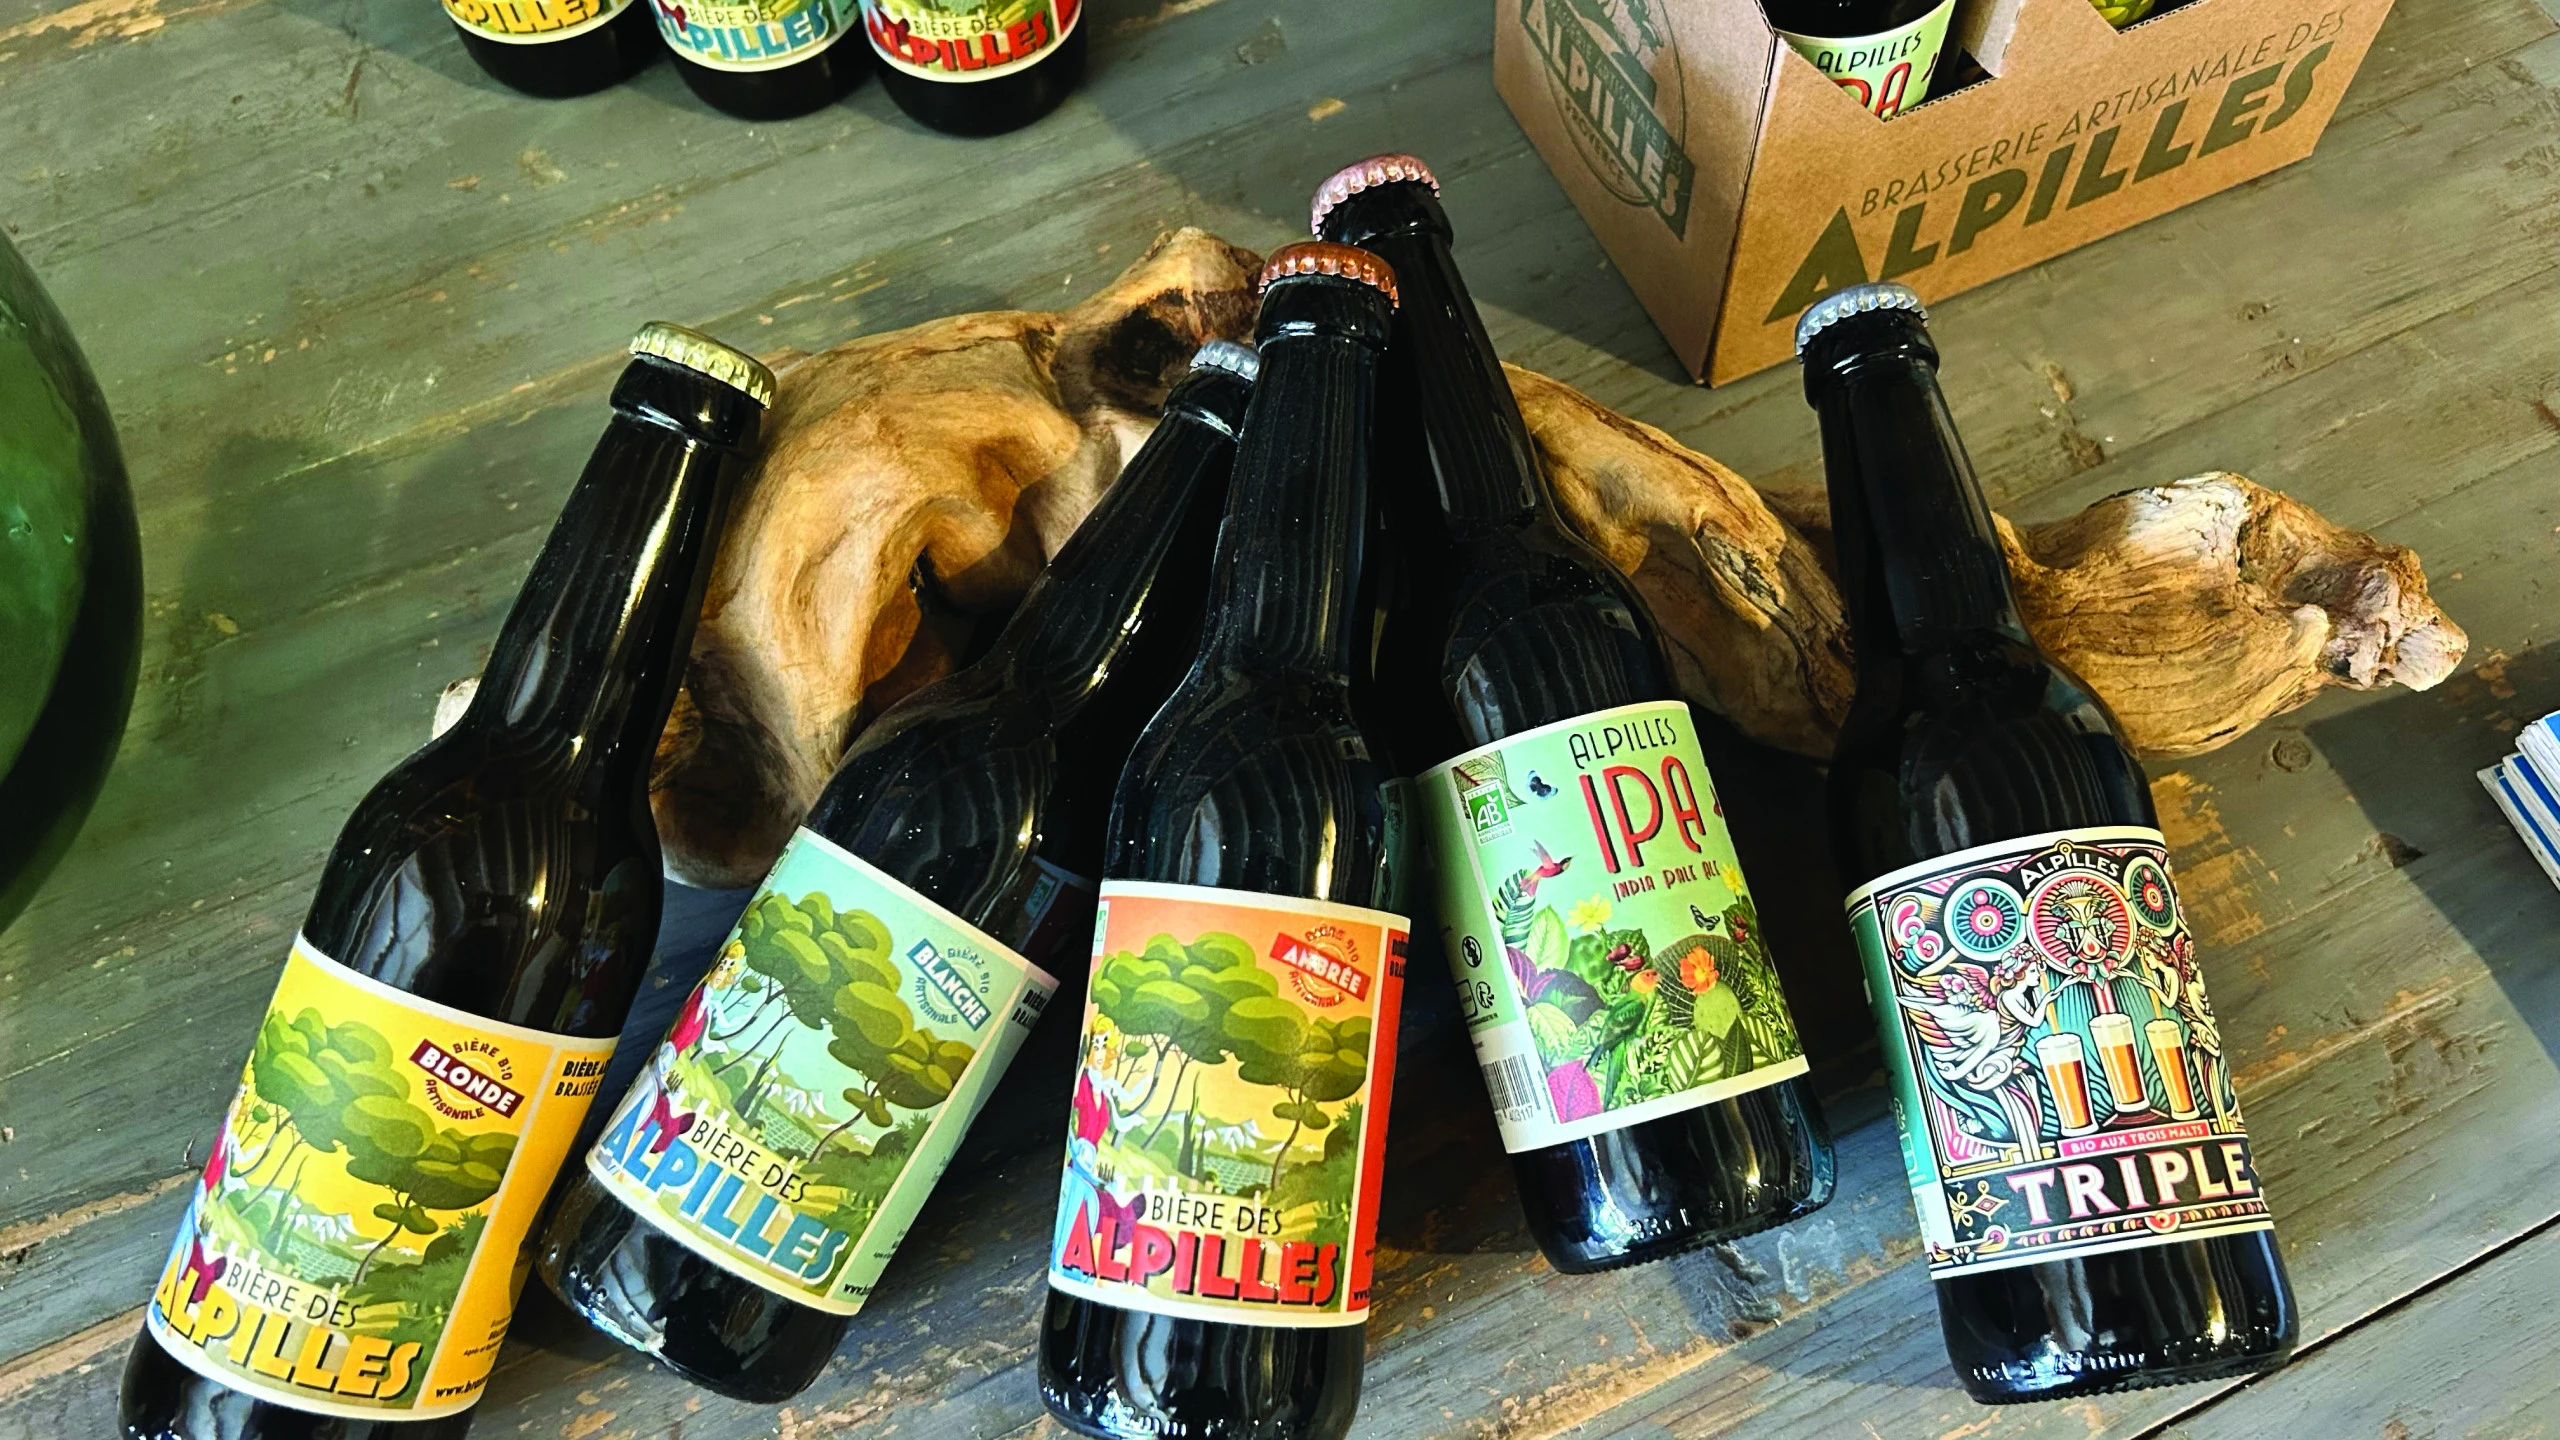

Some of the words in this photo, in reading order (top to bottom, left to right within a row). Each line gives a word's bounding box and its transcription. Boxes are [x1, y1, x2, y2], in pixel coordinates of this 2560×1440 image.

[744, 3, 778, 24] DES
[970, 15, 1004, 35] DES
[1816, 30, 1922, 74] ALPILLES
[1861, 122, 2048, 218] BRASSERIE
[2056, 34, 2277, 142] ARTISANALE
[2284, 9, 2346, 56] DES
[1762, 41, 2335, 325] ALPILLES
[1568, 717, 1677, 770] ALPILLES
[1477, 802, 1503, 832] AB
[1578, 755, 1707, 874] IPA
[1612, 875, 1656, 902] INDIA
[1662, 864, 1698, 889] PALE
[1702, 859, 1721, 880] ALE
[2020, 852, 2120, 890] ALPILLES
[1282, 943, 1362, 995] AMBRÉE
[1345, 938, 1360, 963] BIO
[912, 944, 988, 1025] BLANCHE
[914, 976, 958, 1024] ARTISANALE
[980, 972, 991, 994] BIO
[419, 1046, 516, 1113] BLONDE
[452, 1038, 501, 1057] BIÈRE
[498, 1057, 513, 1081] BIO
[425, 1078, 486, 1121] ARTISANALE
[691, 1119, 762, 1177] BIÈRE
[760, 1162, 812, 1203] DES
[2070, 1140, 2096, 1154] BIO
[2100, 1136, 2127, 1150] AUX
[2130, 1129, 2167, 1145] TROIS
[2169, 1124, 2204, 1138] MALTS
[601, 1098, 850, 1286] ALPILLES
[2005, 1142, 2255, 1226] TRIPLE
[1151, 1192, 1225, 1231] BIÈRE
[1236, 1205, 1283, 1236] DES
[1062, 1199, 1340, 1307] ALPILLES
[227, 1261, 300, 1313] BIÈRE
[306, 1293, 362, 1328] DES
[155, 1247, 424, 1401] ALPILLES
